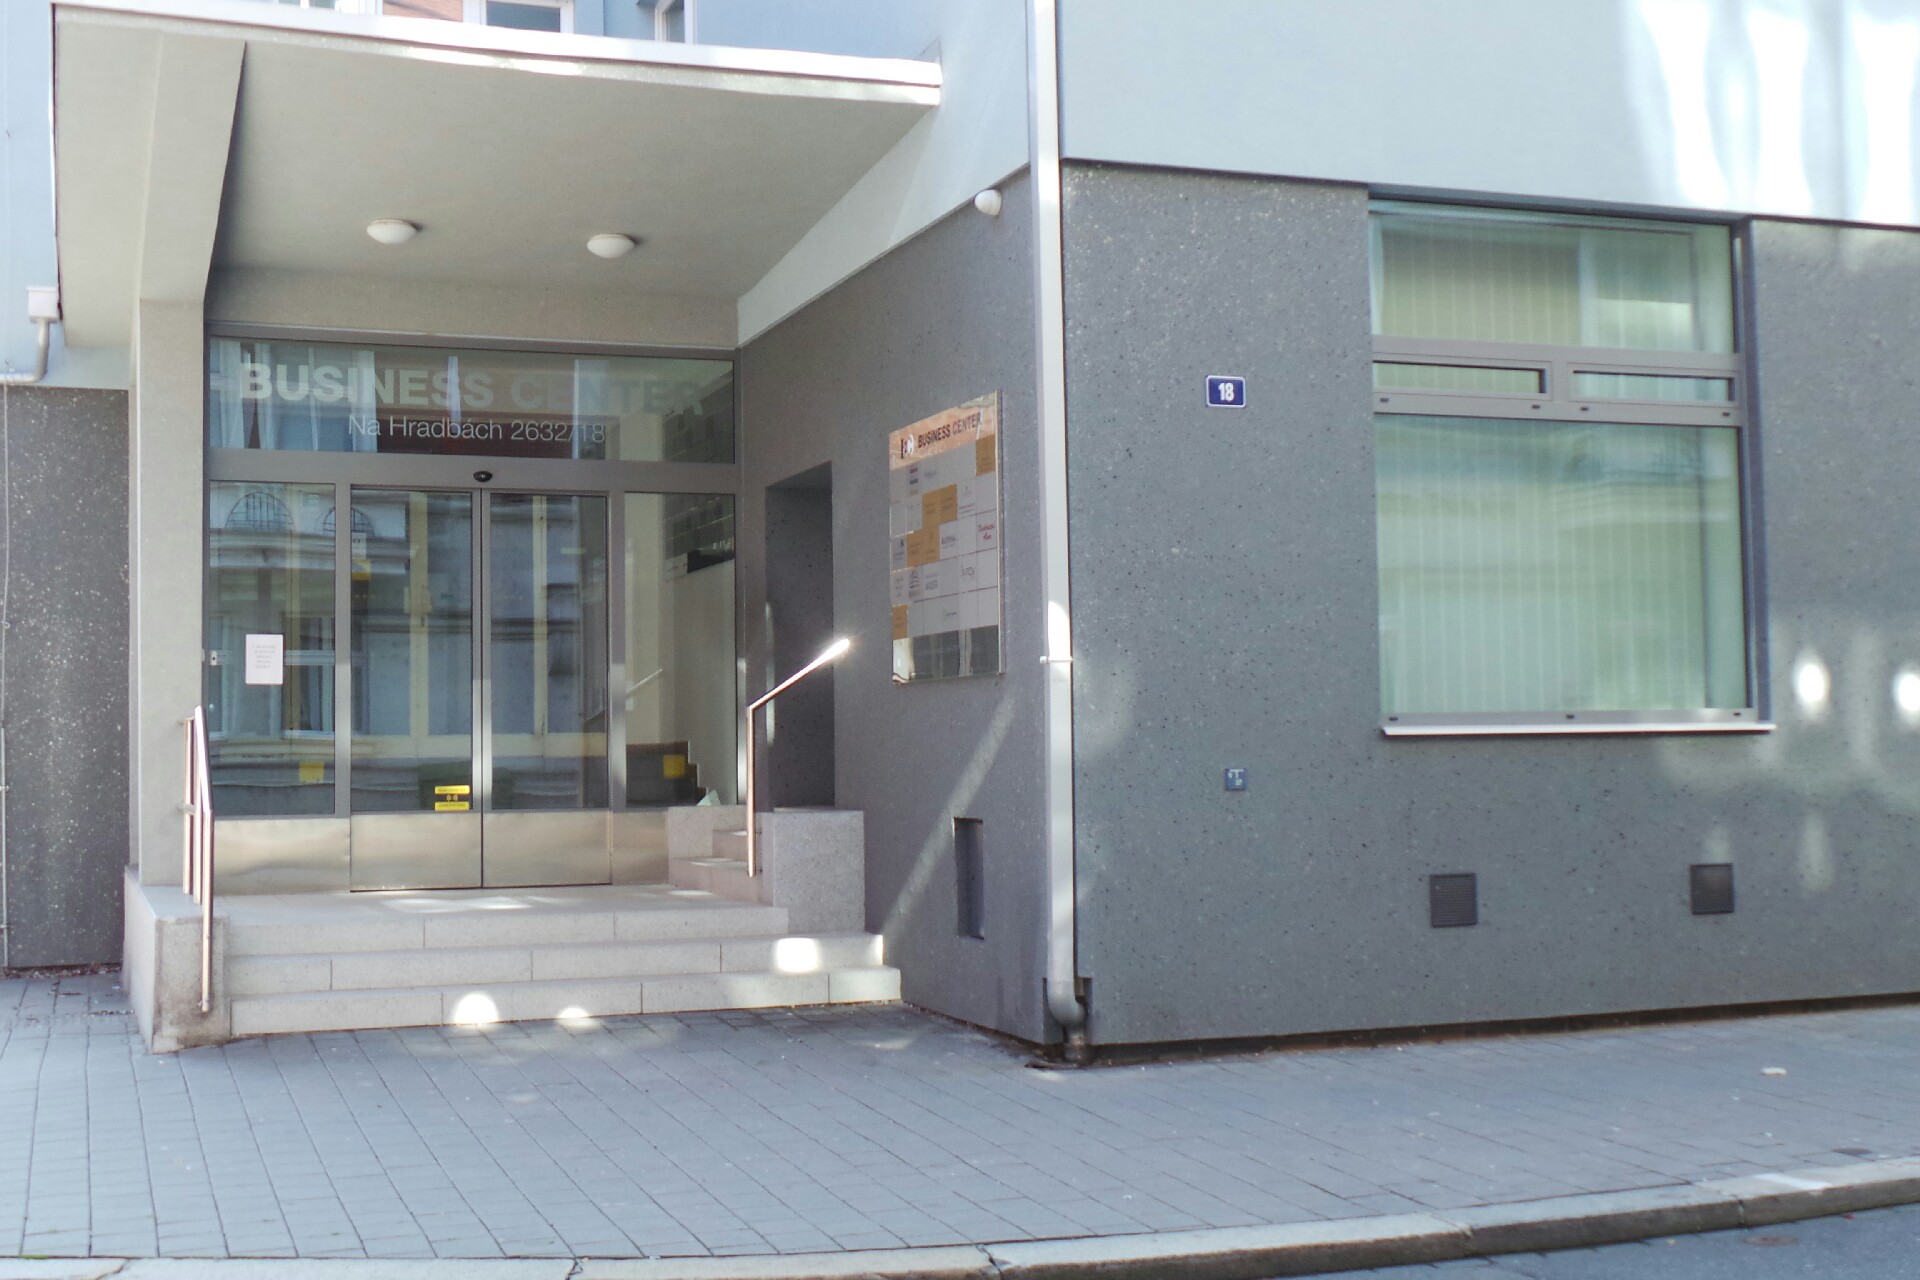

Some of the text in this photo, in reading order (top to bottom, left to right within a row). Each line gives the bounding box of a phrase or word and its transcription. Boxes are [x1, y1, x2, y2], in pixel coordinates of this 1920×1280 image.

[240, 362, 703, 415] BUSINESS CENTER
[1218, 382, 1235, 401] 18
[349, 414, 605, 442] Na Hradbách 2632/18
[917, 424, 951, 448] BUSINESS
